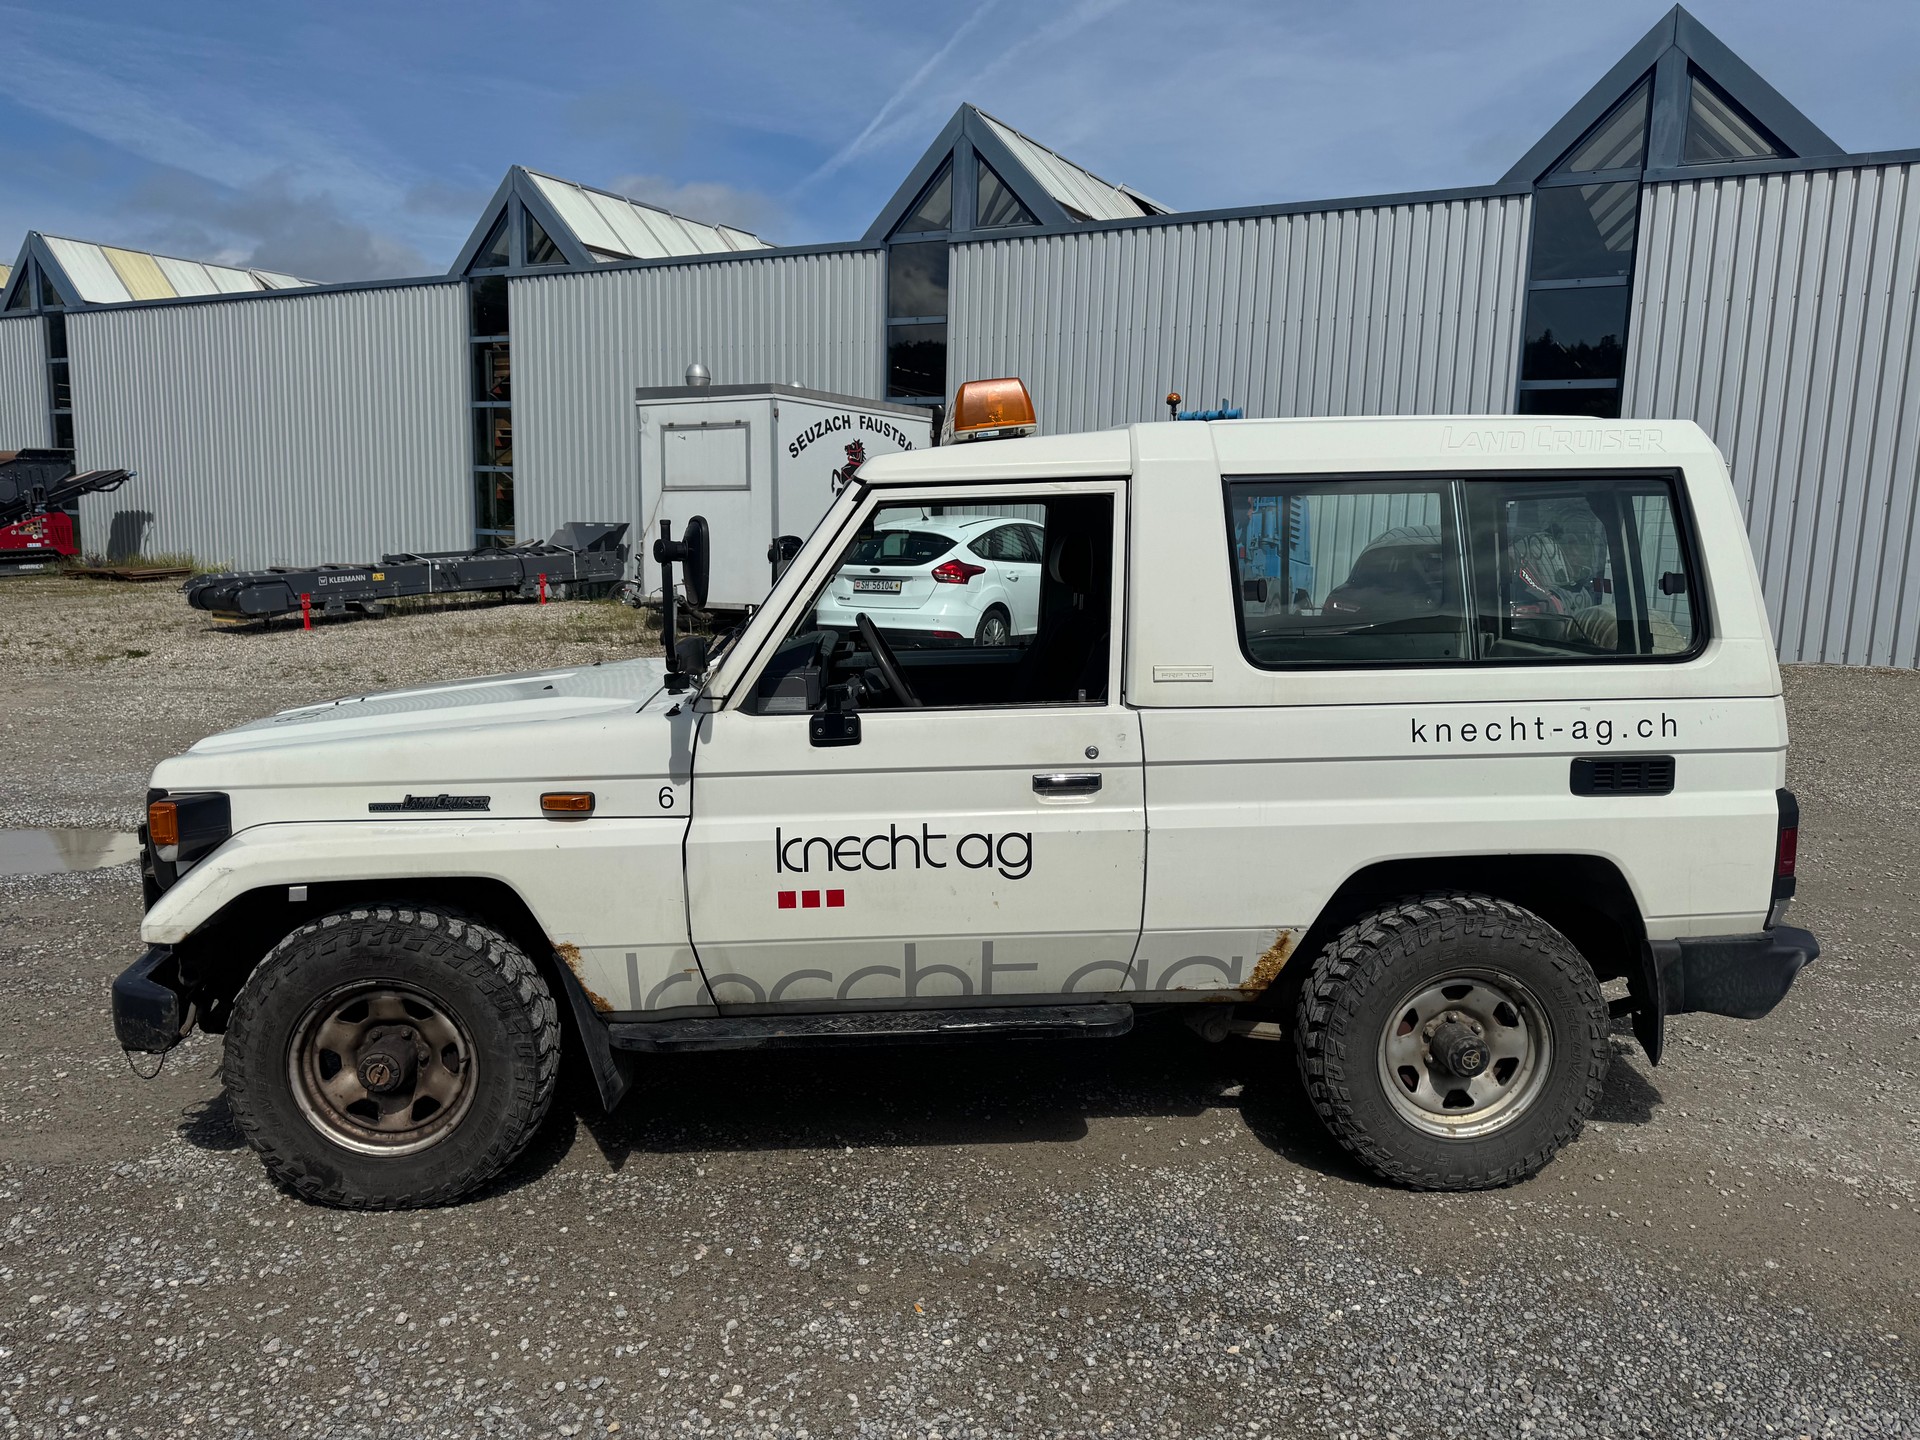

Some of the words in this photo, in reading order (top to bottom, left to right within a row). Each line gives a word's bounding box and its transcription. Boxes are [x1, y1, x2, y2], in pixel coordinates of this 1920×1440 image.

[788, 414, 852, 459] SEUZACH
[859, 415, 917, 451] FAUSTBA
[1440, 425, 1526, 453] LAND
[1531, 425, 1668, 455] CRUISER
[328, 574, 366, 583] KLEEMANN
[1411, 713, 1678, 745] knecht-ag.ch
[658, 786, 675, 808] 6
[776, 823, 947, 873] knecht
[956, 832, 1032, 880] ag
